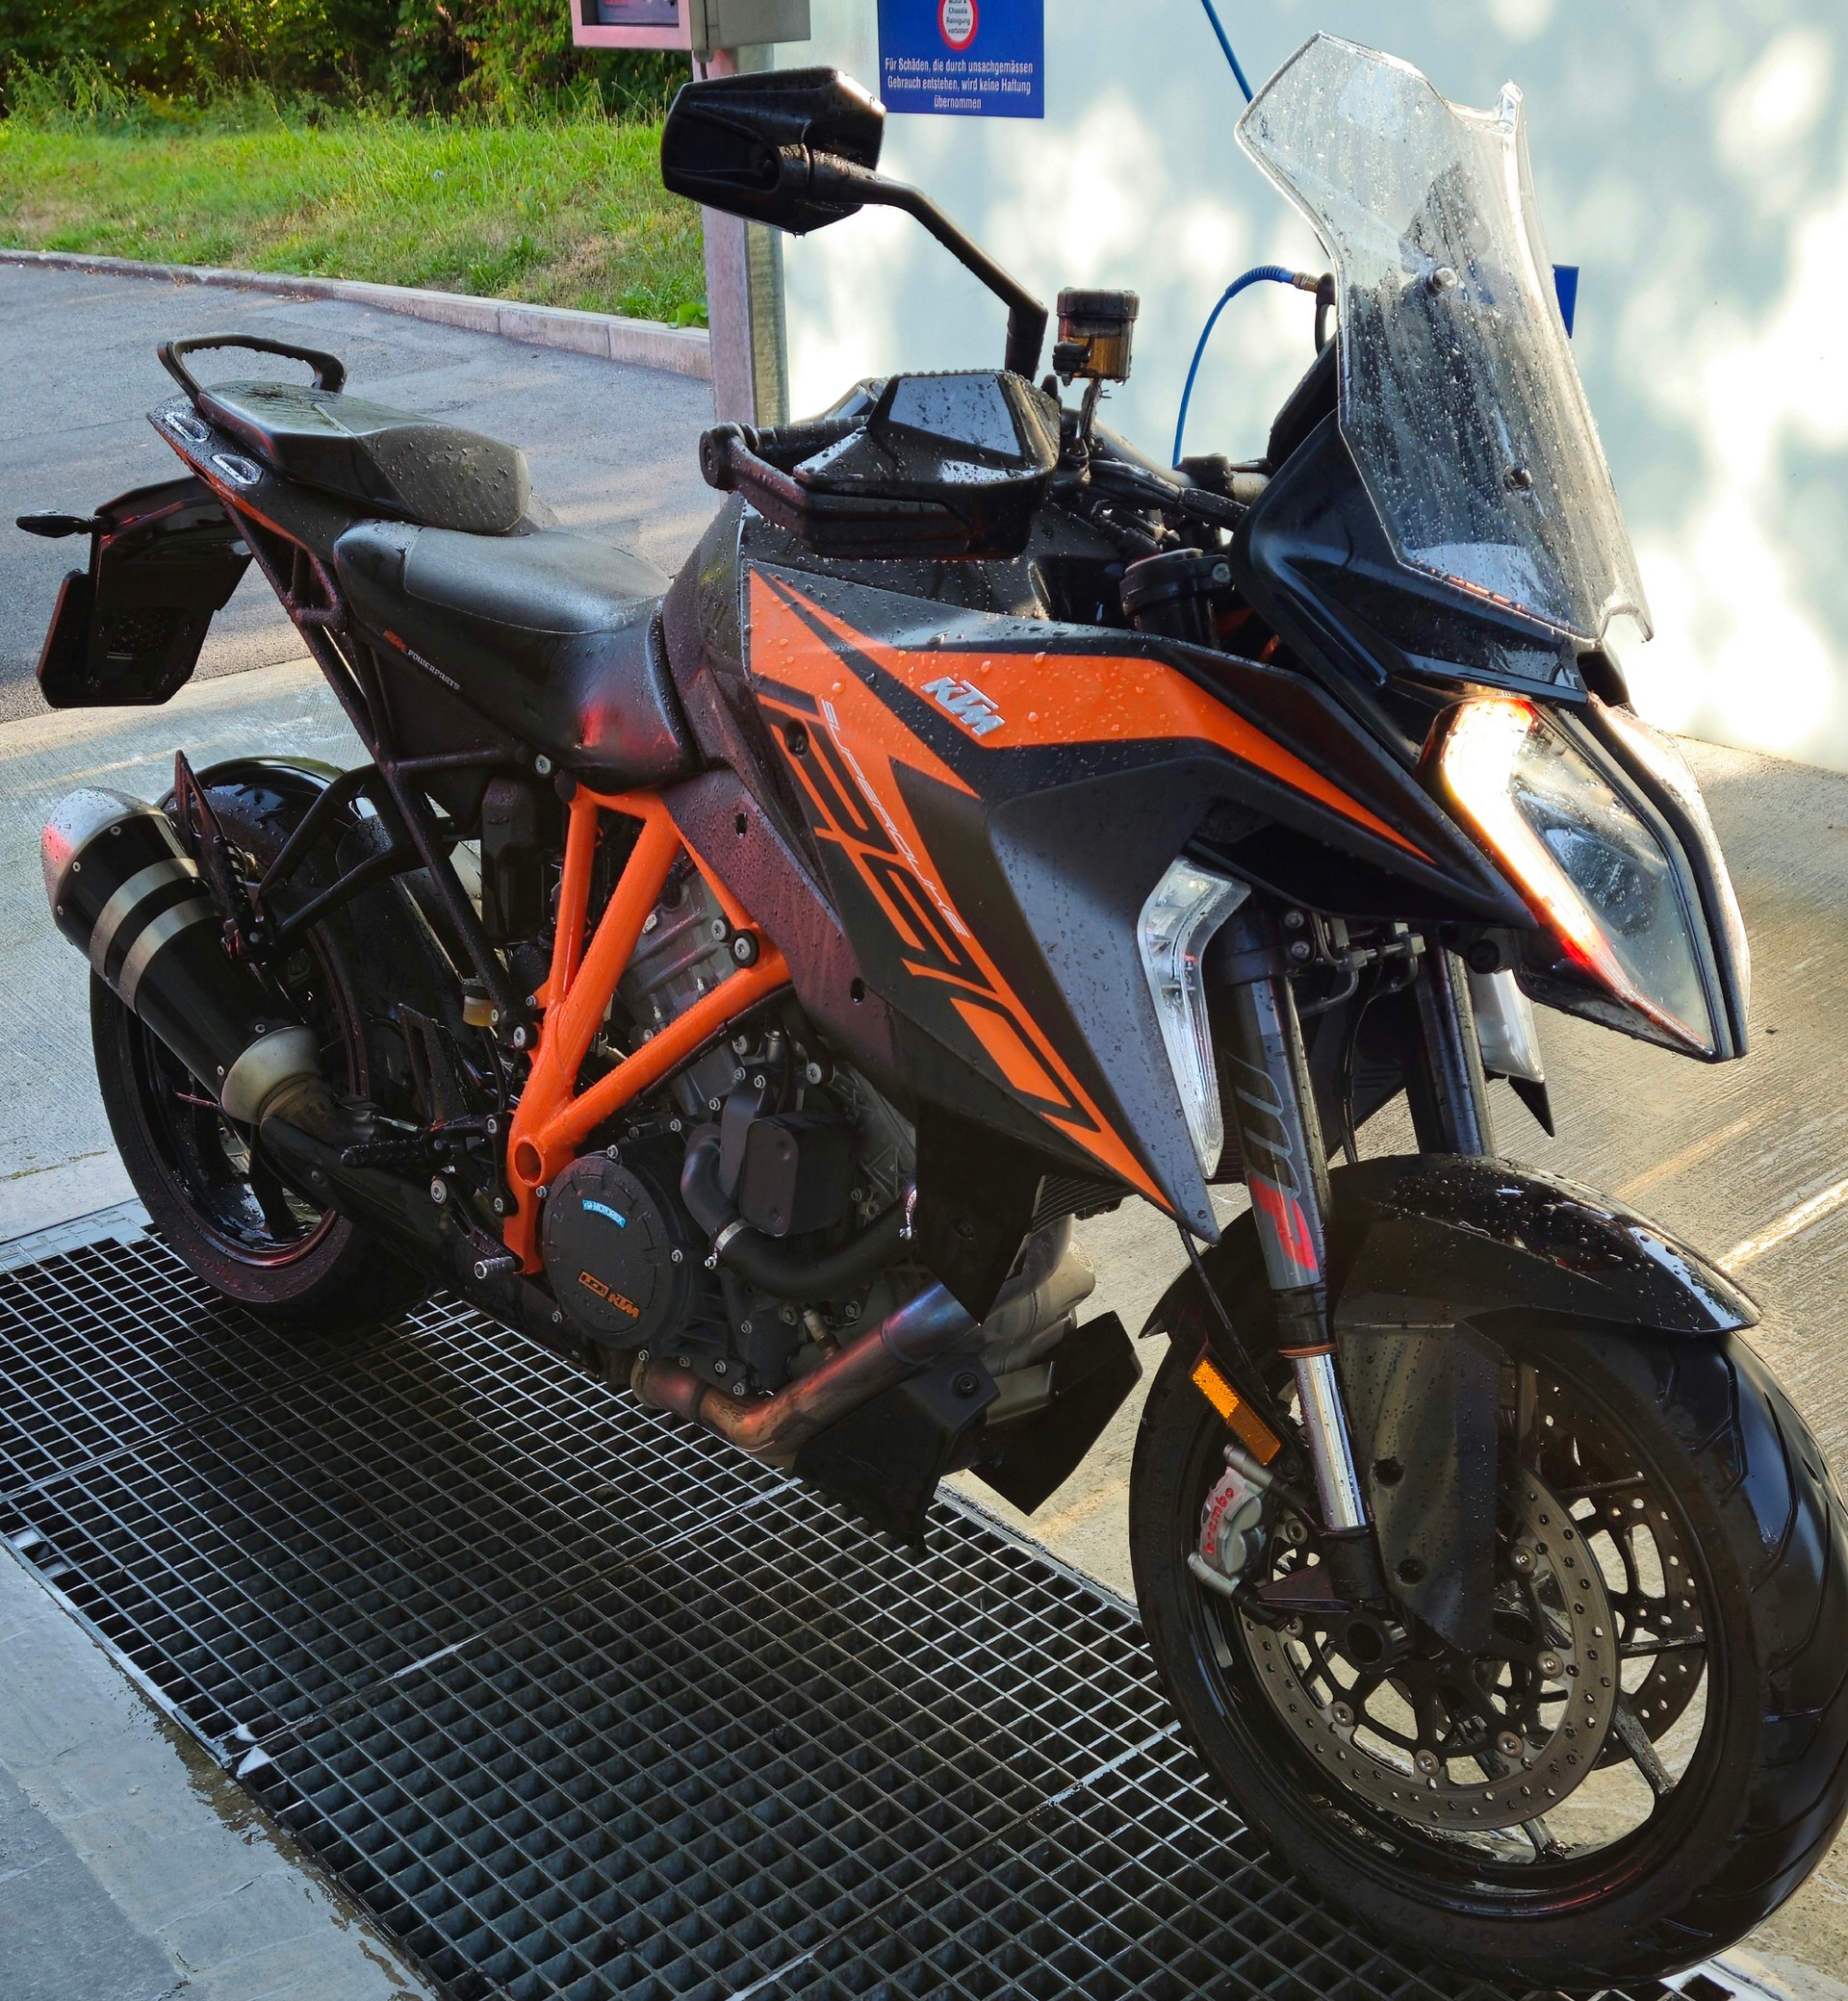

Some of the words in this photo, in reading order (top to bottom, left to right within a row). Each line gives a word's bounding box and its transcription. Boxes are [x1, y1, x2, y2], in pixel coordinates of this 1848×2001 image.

[885, 58, 897, 70] Für
[898, 58, 932, 73] Schäden,
[933, 59, 944, 71] die
[945, 59, 966, 72] durch
[968, 60, 1034, 76] unsachgemässen
[887, 75, 921, 89] Gebrauch
[922, 77, 960, 91] entstehen,
[962, 77, 978, 90] wird
[979, 78, 1000, 91] keine
[1001, 79, 1031, 94] Haftung
[934, 95, 982, 109] übernommen
[408, 649, 461, 690] POWERPARTS
[920, 676, 1006, 736] KTM
[607, 1293, 640, 1319] KTM
[1201, 1487, 1234, 1554] brembo
